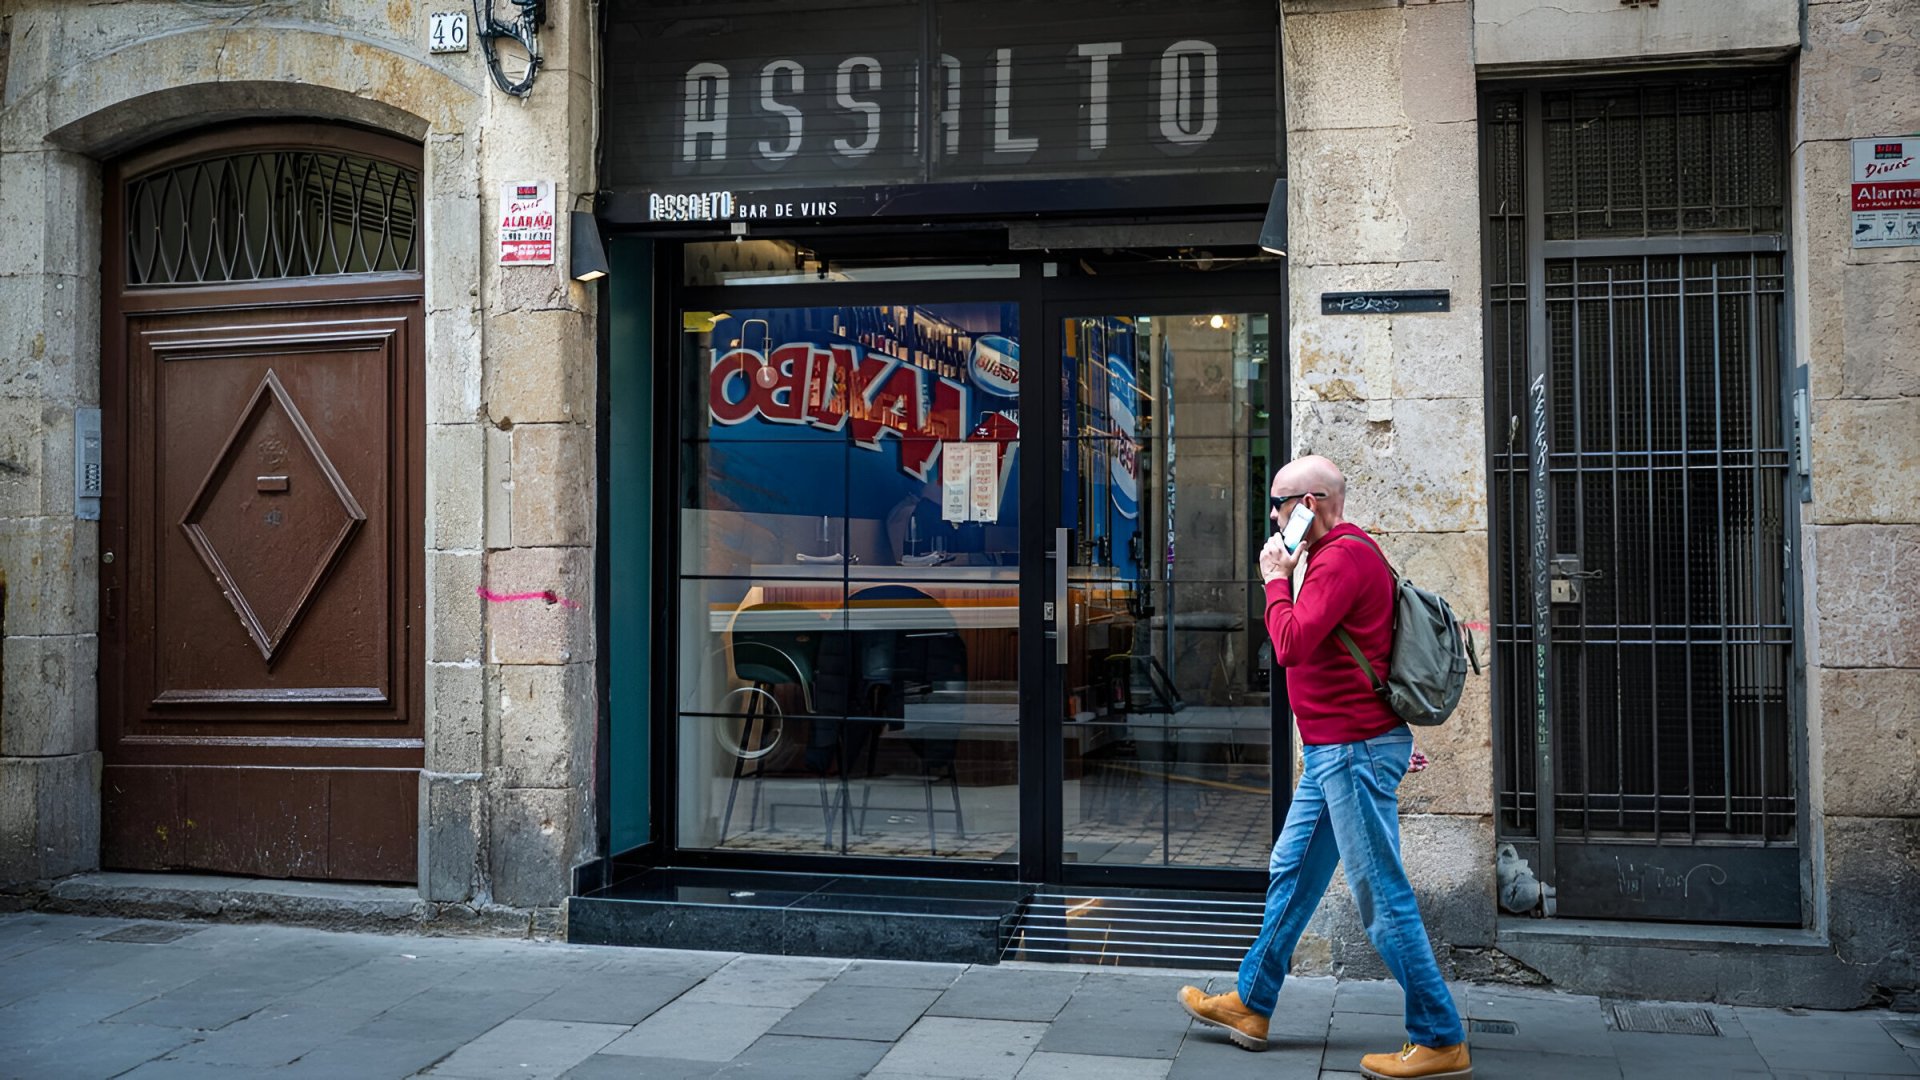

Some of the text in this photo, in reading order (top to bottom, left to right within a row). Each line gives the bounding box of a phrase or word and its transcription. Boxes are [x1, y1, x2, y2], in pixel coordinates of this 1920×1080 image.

[433, 16, 464, 44] 46
[682, 40, 1218, 162] ASSALTO
[739, 204, 767, 218] BAR
[775, 203, 793, 217] DE
[801, 201, 838, 216] VINS
